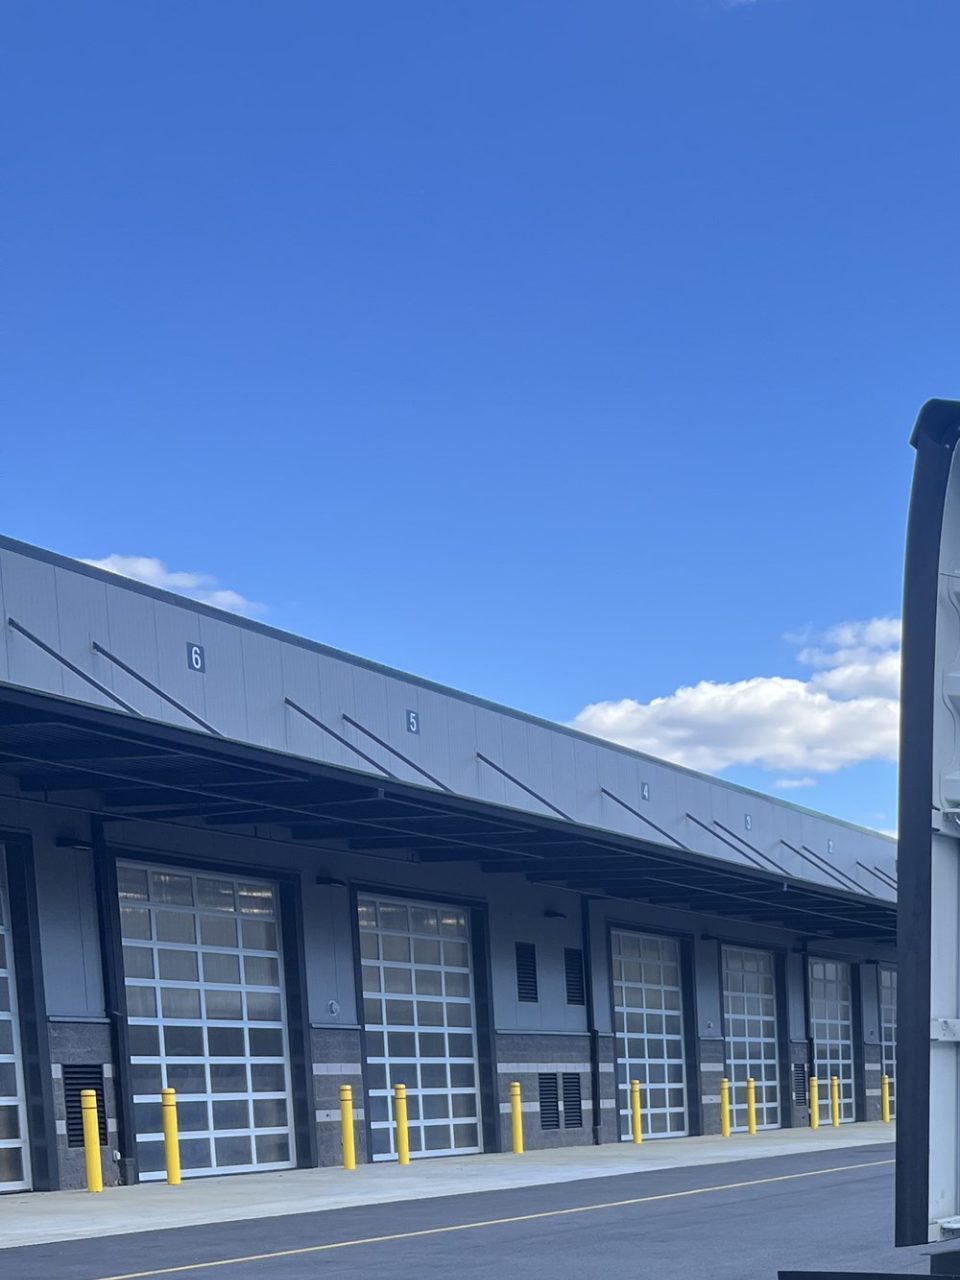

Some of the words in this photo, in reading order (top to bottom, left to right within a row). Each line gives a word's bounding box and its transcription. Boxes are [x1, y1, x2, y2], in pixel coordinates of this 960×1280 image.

[192, 646, 201, 669] 6
[410, 712, 417, 731] 5
[643, 784, 649, 799] 4
